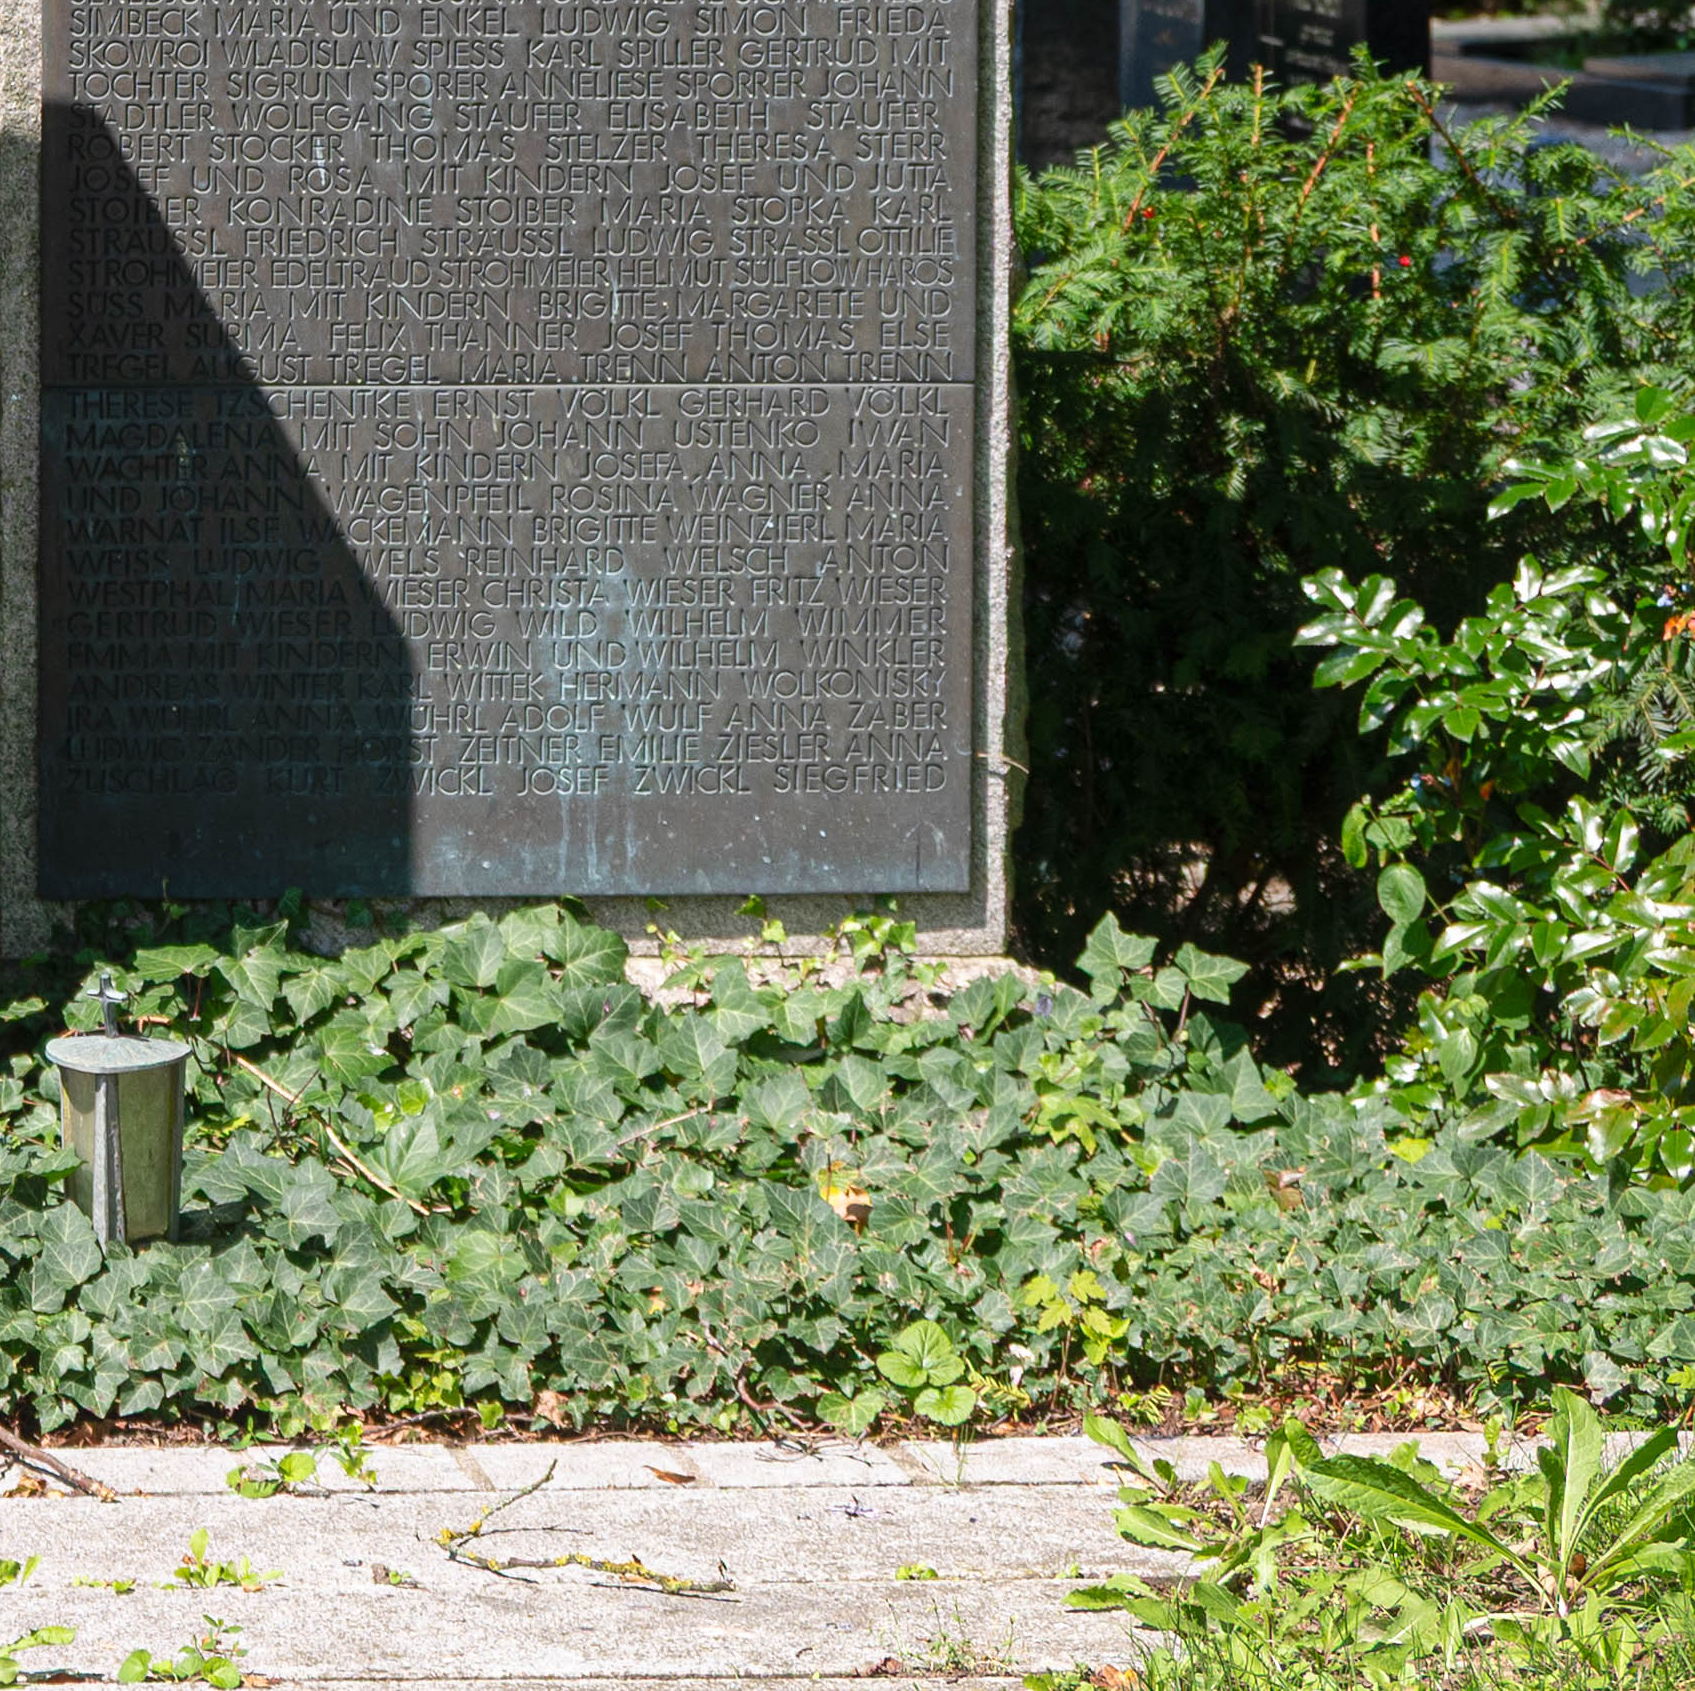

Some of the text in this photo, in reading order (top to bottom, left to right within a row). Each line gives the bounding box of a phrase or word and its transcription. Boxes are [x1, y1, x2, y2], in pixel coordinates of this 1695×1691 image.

[69, 195, 954, 226] STOIBER KONRADINE STOIBER MARIA STOPKA KARL
[266, 767, 345, 796] KURT
[378, 767, 493, 796] ZWICKL
[516, 766, 611, 796] JOSEF
[632, 766, 752, 796] ZWICKL
[772, 765, 948, 796] SIEGFRIED
